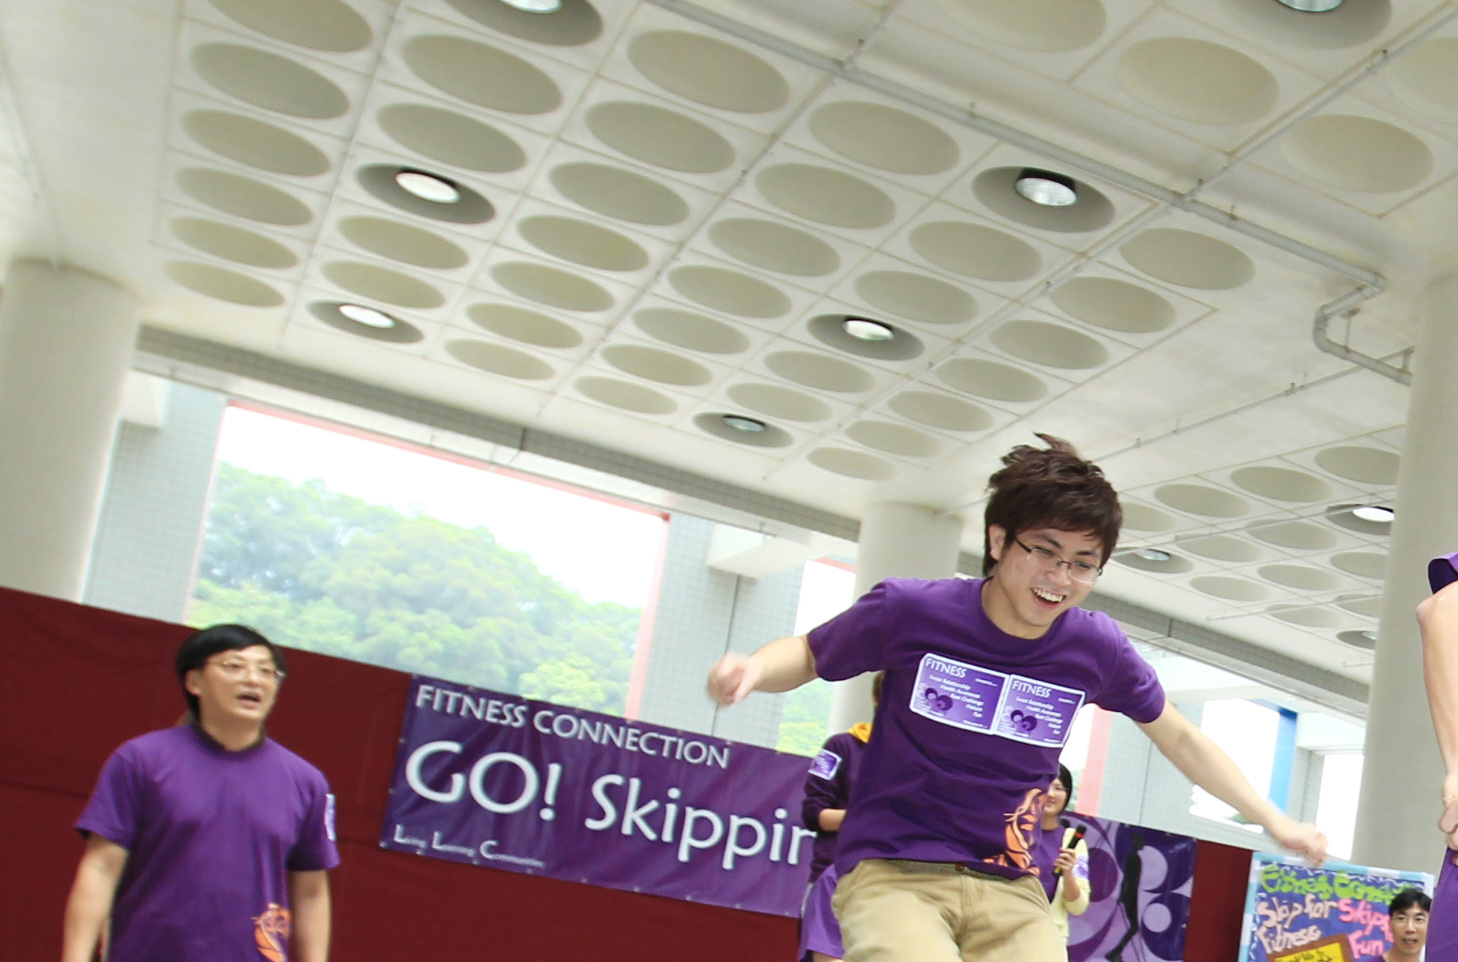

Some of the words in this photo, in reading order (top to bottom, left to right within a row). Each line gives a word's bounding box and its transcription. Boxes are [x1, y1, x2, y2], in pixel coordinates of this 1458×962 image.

[925, 658, 967, 678] FITNESS
[1012, 680, 1052, 698] FITNESS
[415, 684, 528, 728] FITNESS
[533, 709, 730, 769] CONNECTION
[405, 740, 563, 821] GO!
[1347, 929, 1385, 960] Fun
